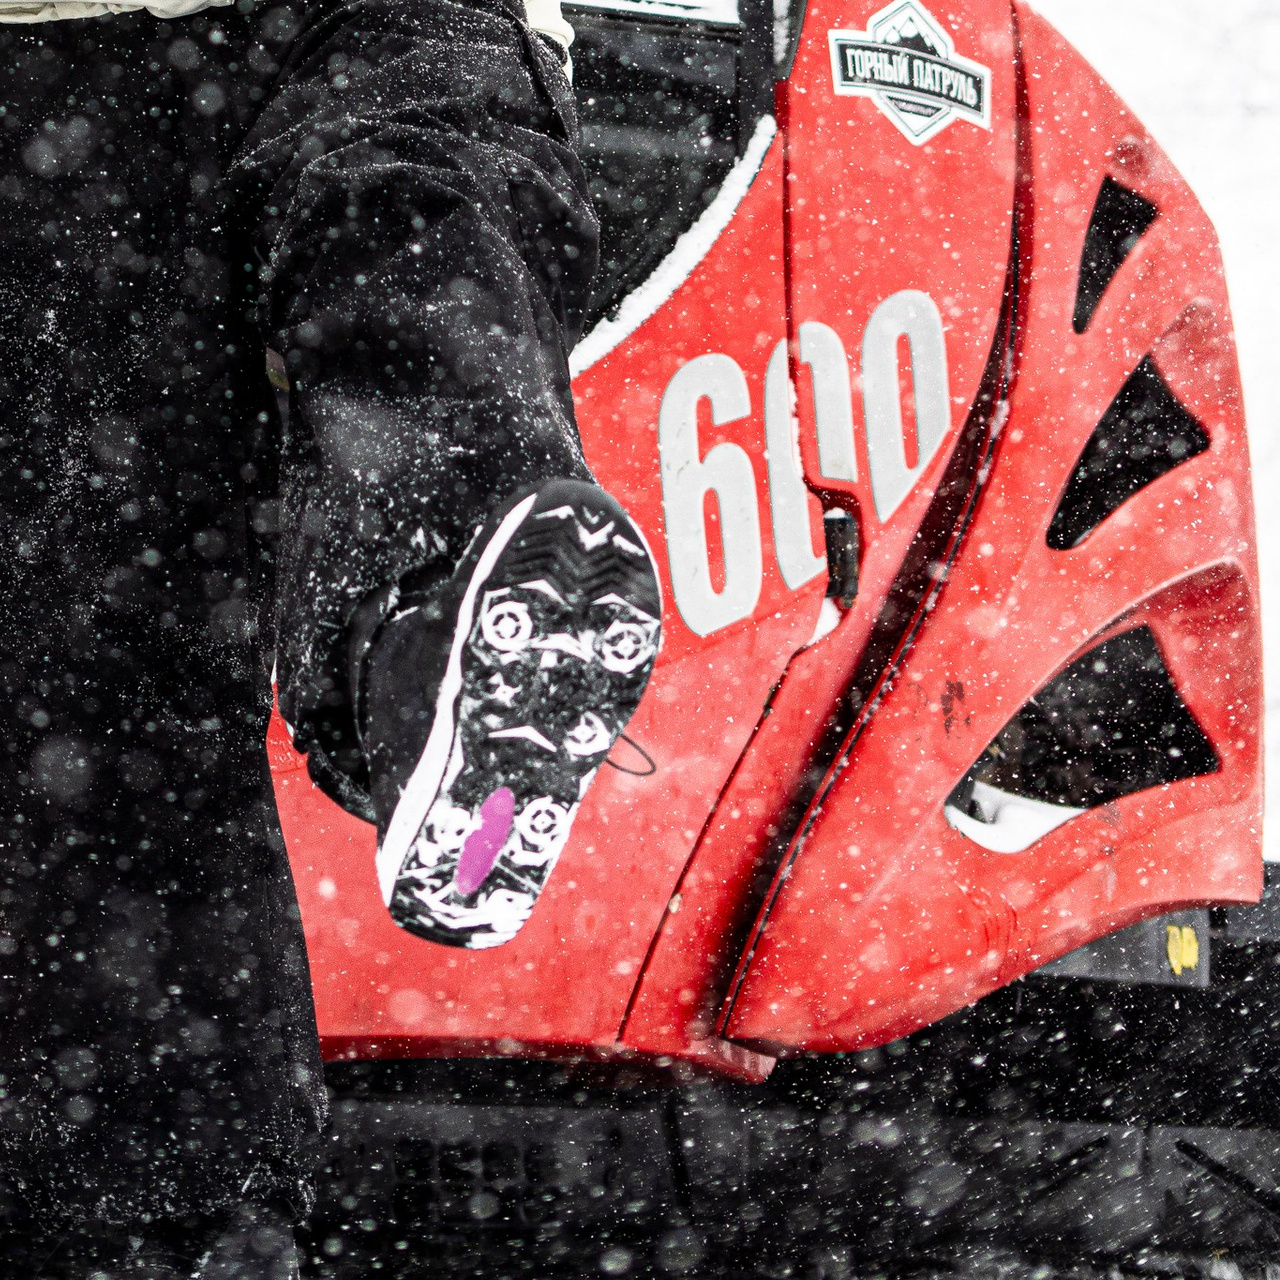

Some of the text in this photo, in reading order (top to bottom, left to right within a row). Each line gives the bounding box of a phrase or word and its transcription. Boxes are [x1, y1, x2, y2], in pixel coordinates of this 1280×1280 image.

[845, 48, 978, 108] ГОРНЫЙ ПАТРУЛЬ
[658, 289, 952, 638] 600
